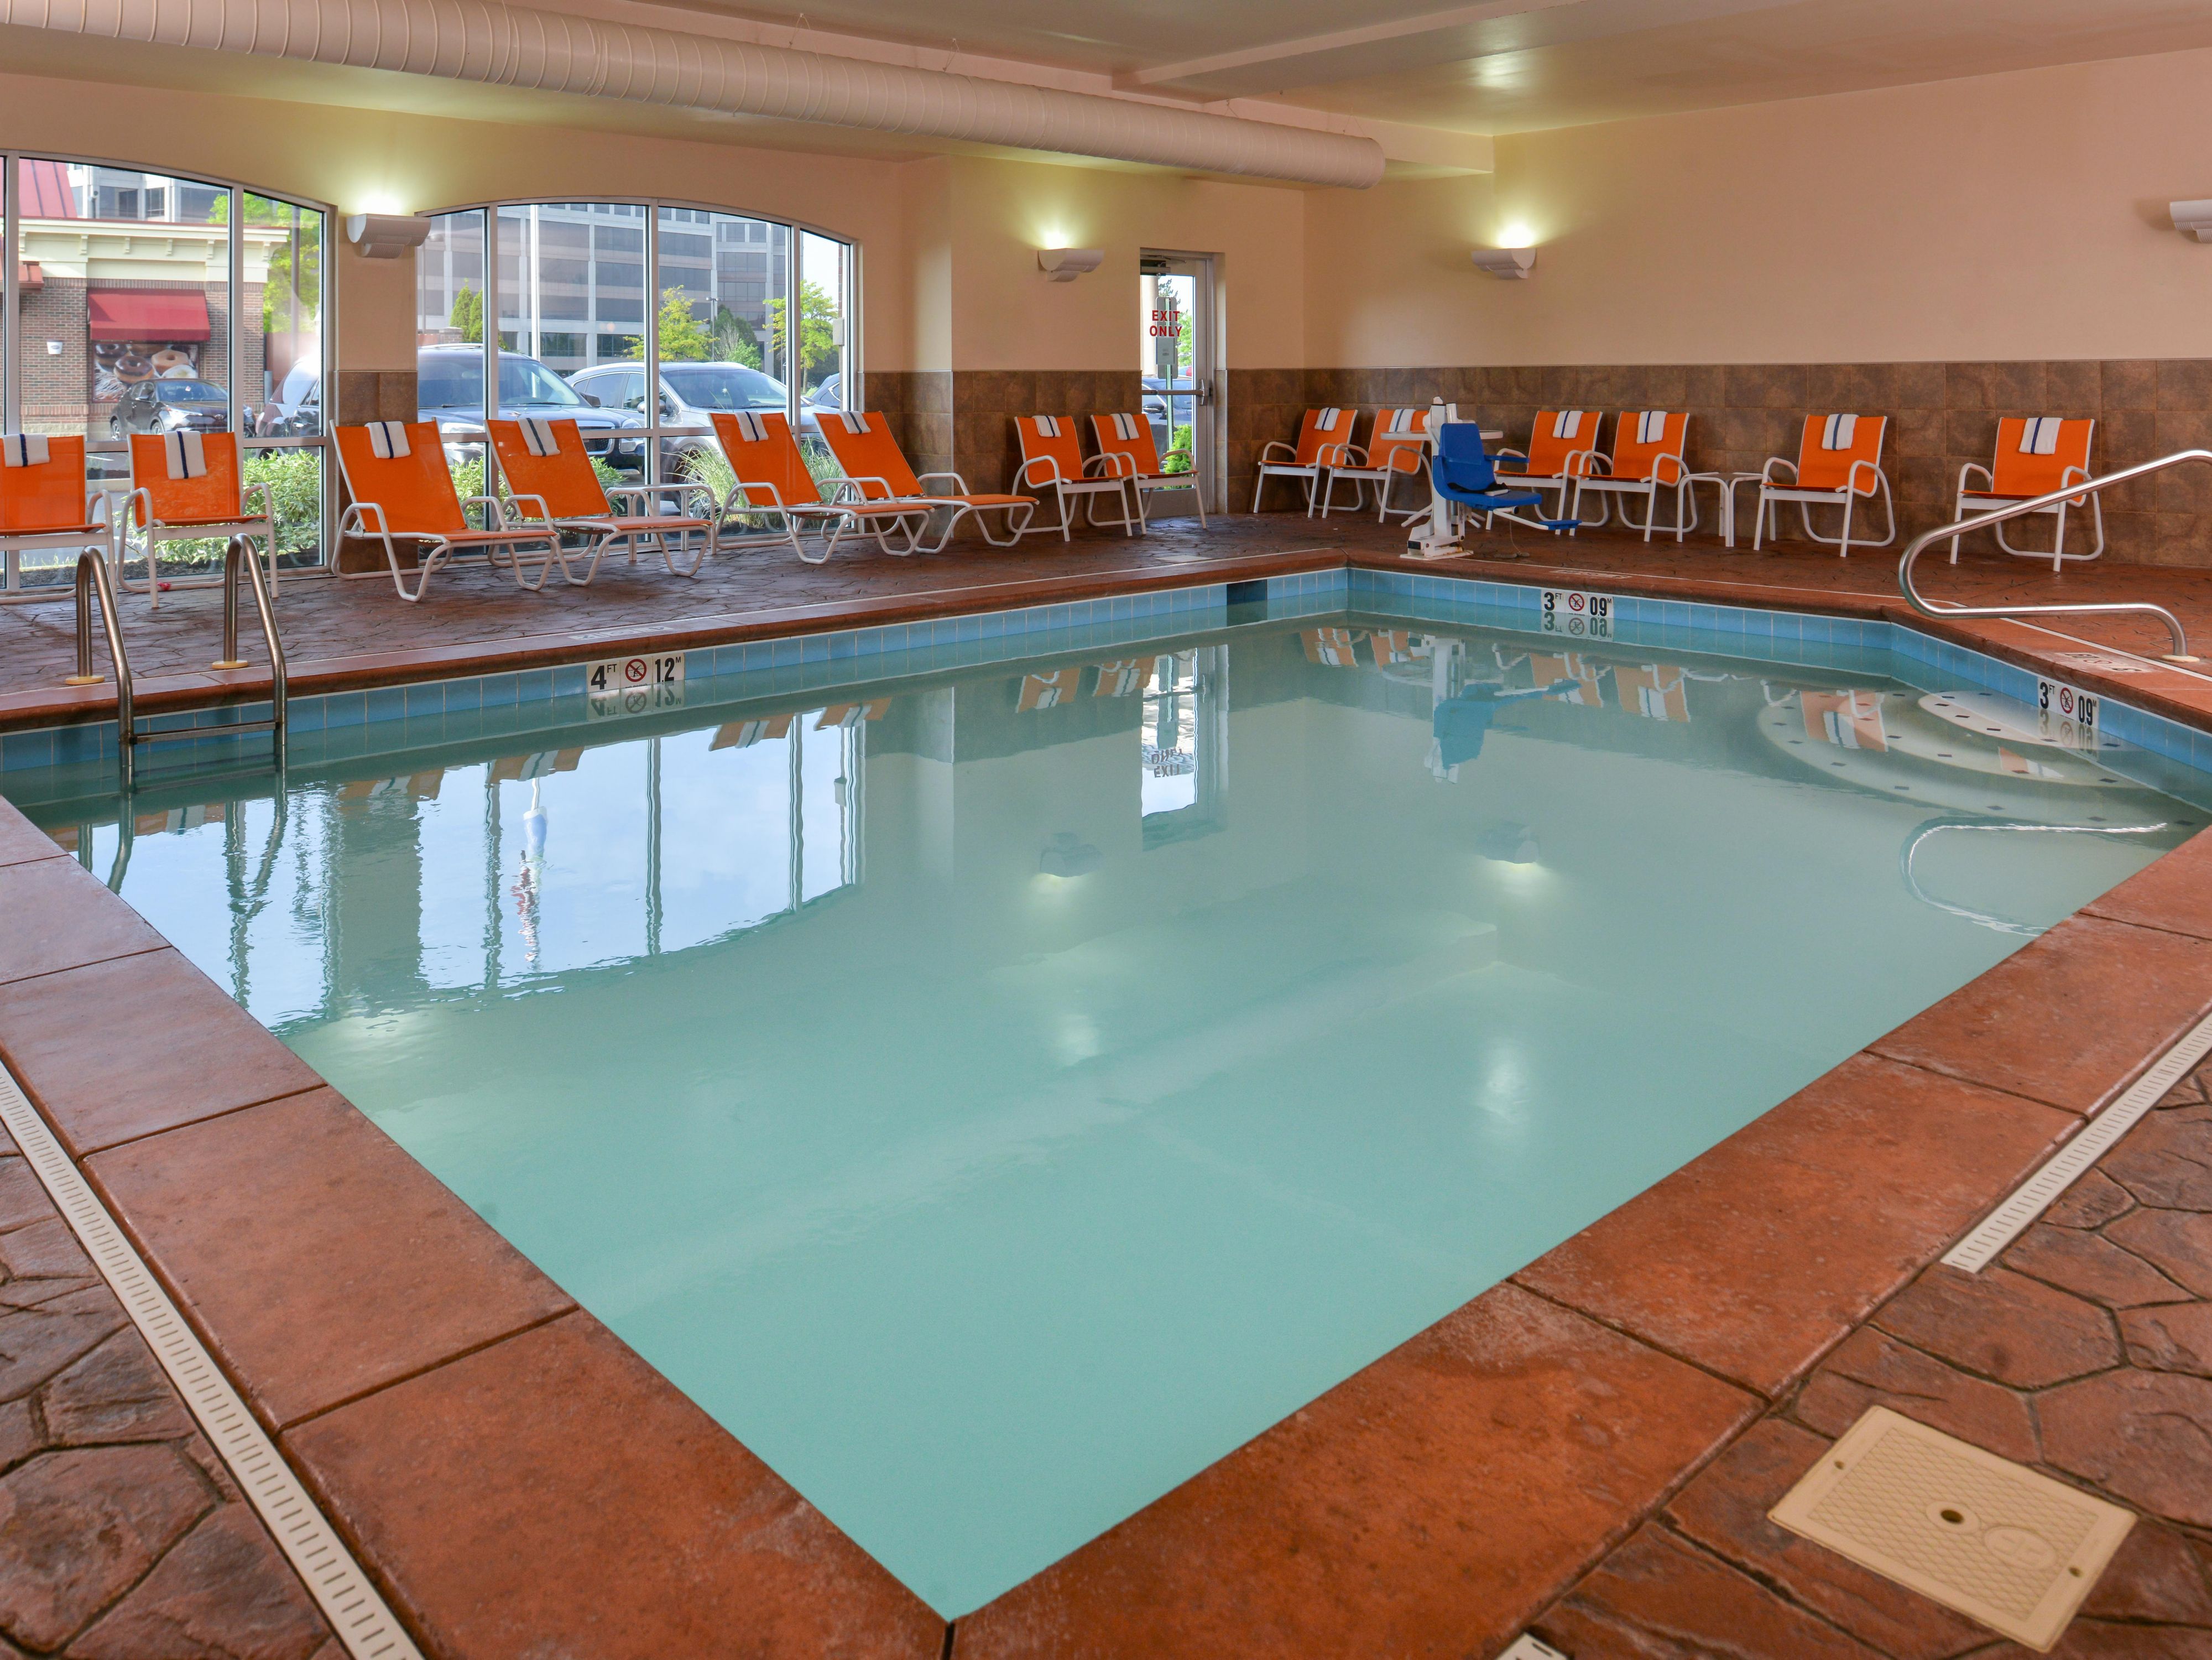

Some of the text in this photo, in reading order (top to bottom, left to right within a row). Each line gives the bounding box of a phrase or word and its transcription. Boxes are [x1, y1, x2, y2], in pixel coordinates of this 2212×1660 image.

[1152, 310, 1180, 322] EXIT
[1149, 325, 1182, 337] ONLY
[1544, 592, 1555, 611] 3
[1590, 596, 1607, 617] 0.9
[591, 665, 607, 690] 4
[607, 664, 617, 673] FT
[655, 657, 675, 683] 1.2
[2039, 681, 2049, 709] 3
[2049, 685, 2056, 694] FT
[2078, 695, 2093, 726] 0.9
